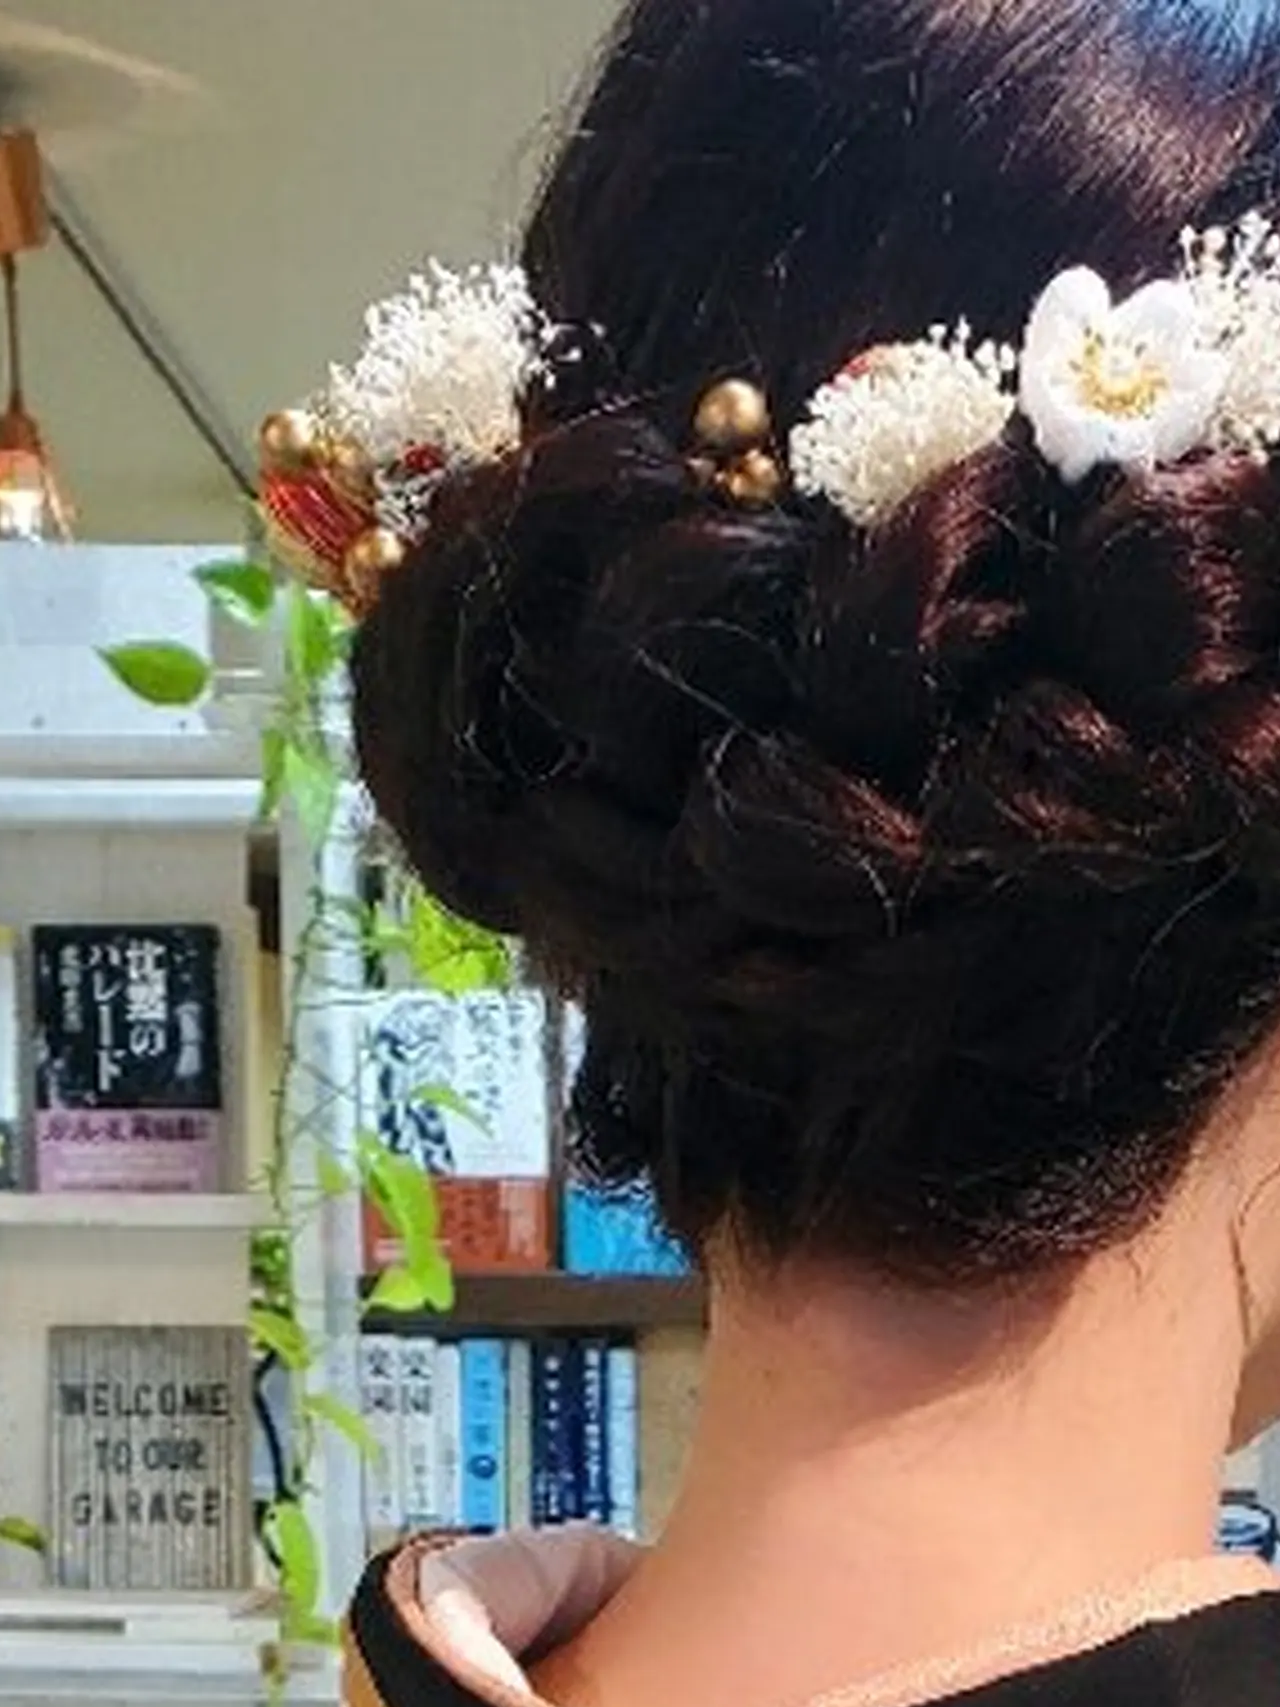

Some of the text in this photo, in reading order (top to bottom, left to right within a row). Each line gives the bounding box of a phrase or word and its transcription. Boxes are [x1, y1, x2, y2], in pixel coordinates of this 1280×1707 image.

[58, 1383, 229, 1417] WELCOME
[94, 1437, 205, 1473] TO OUR
[73, 1489, 220, 1526] GARAGE
